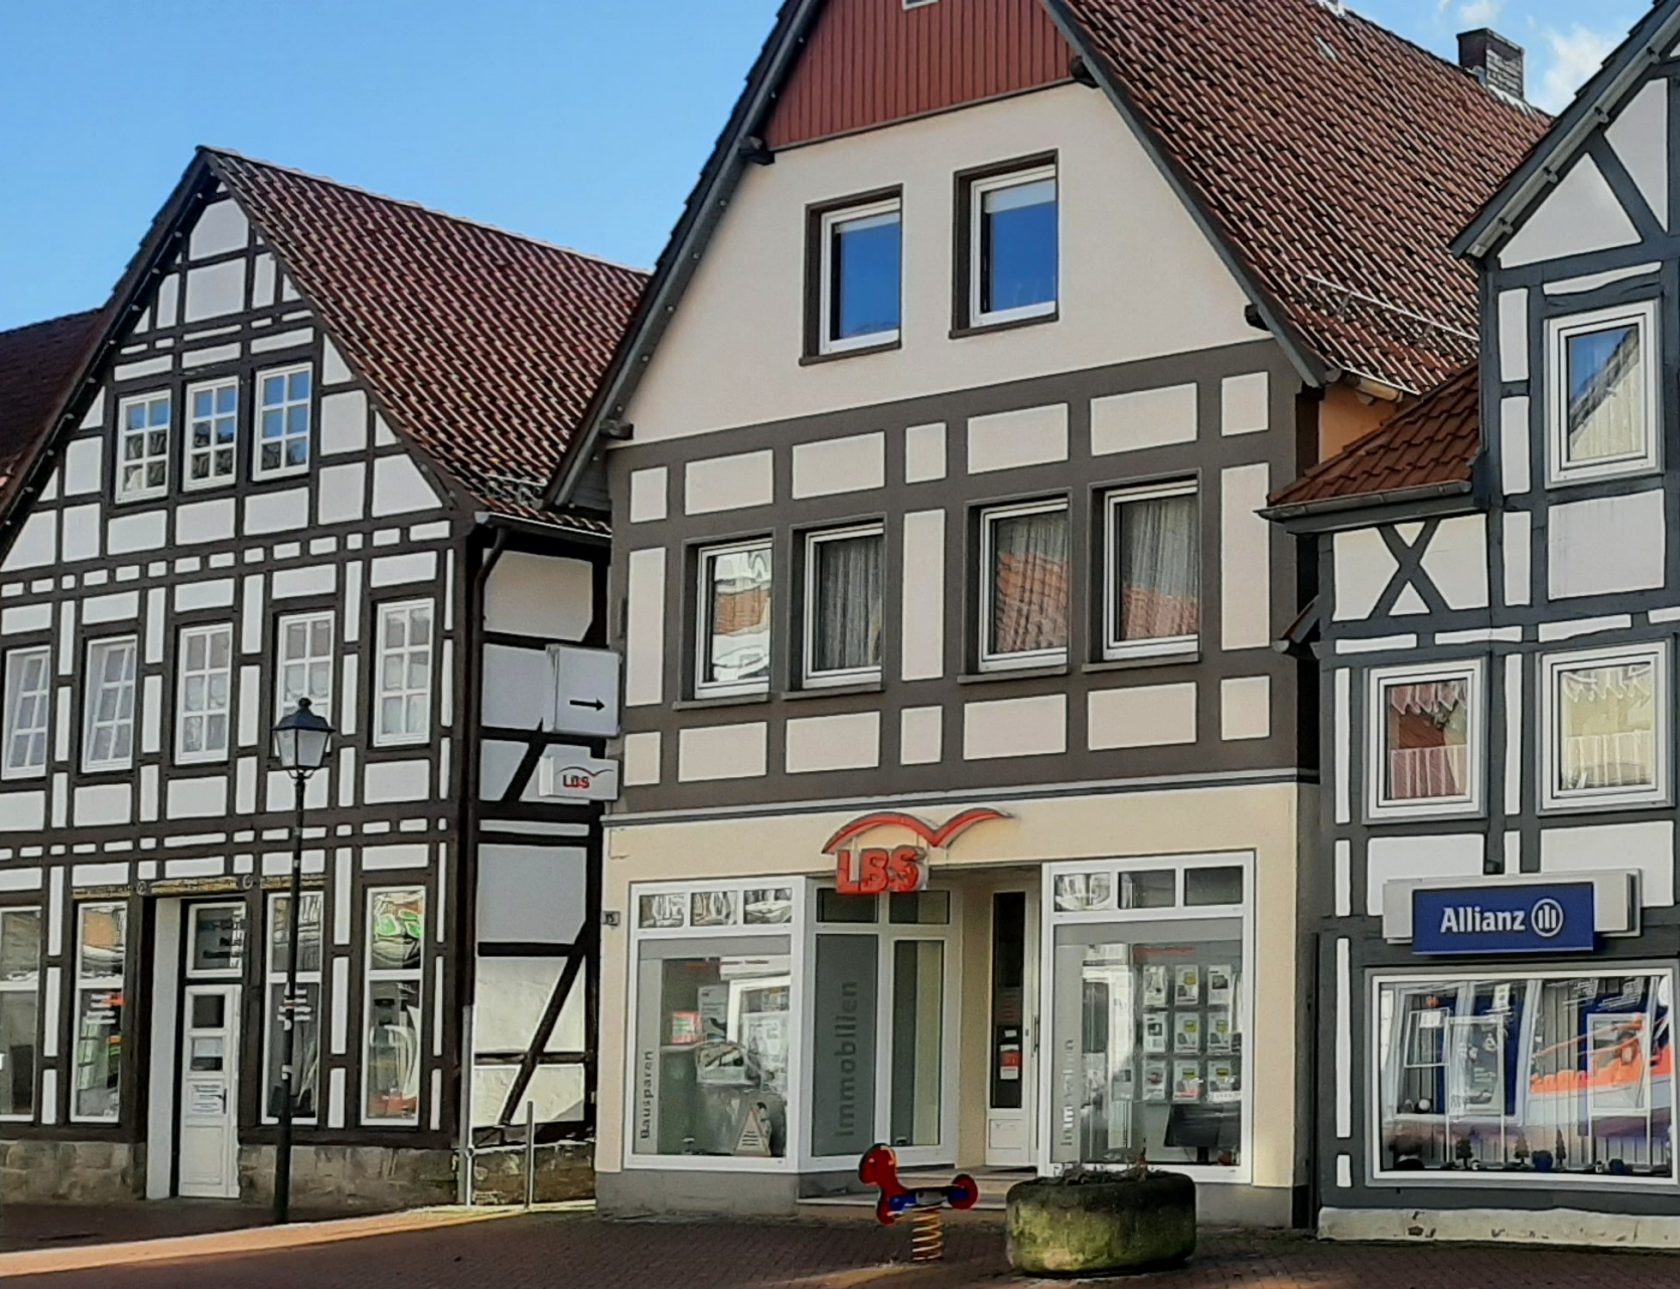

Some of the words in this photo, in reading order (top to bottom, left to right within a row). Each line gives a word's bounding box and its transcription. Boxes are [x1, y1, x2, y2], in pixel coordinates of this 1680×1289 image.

[836, 845, 922, 895] LBS
[1440, 905, 1526, 934] Allianz
[835, 981, 857, 1137] Immobilien
[640, 1051, 655, 1140] Bausparen
